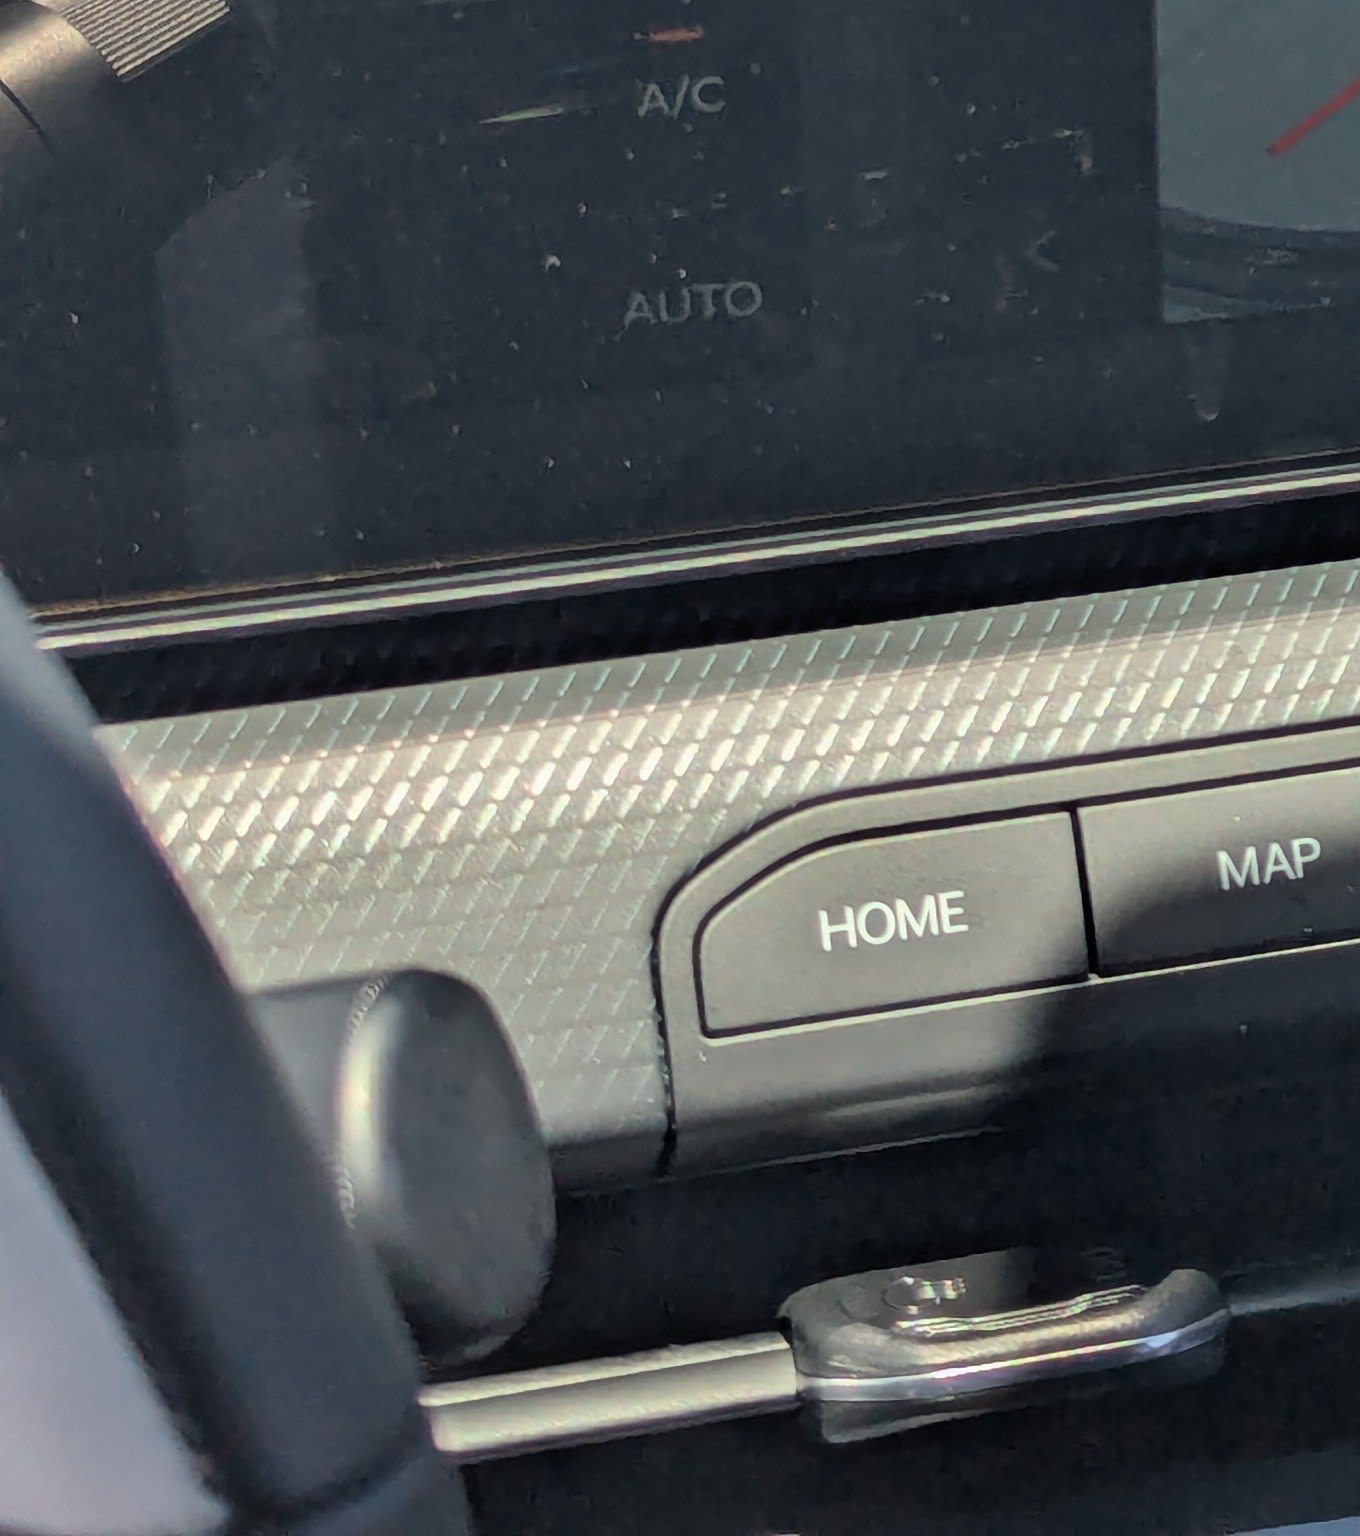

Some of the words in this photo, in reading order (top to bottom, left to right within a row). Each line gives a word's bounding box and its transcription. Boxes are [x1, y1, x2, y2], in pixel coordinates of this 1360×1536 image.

[635, 74, 727, 118] A/C
[622, 279, 765, 332] AUTO
[1215, 837, 1324, 892] MAP
[817, 890, 971, 953] HOME
